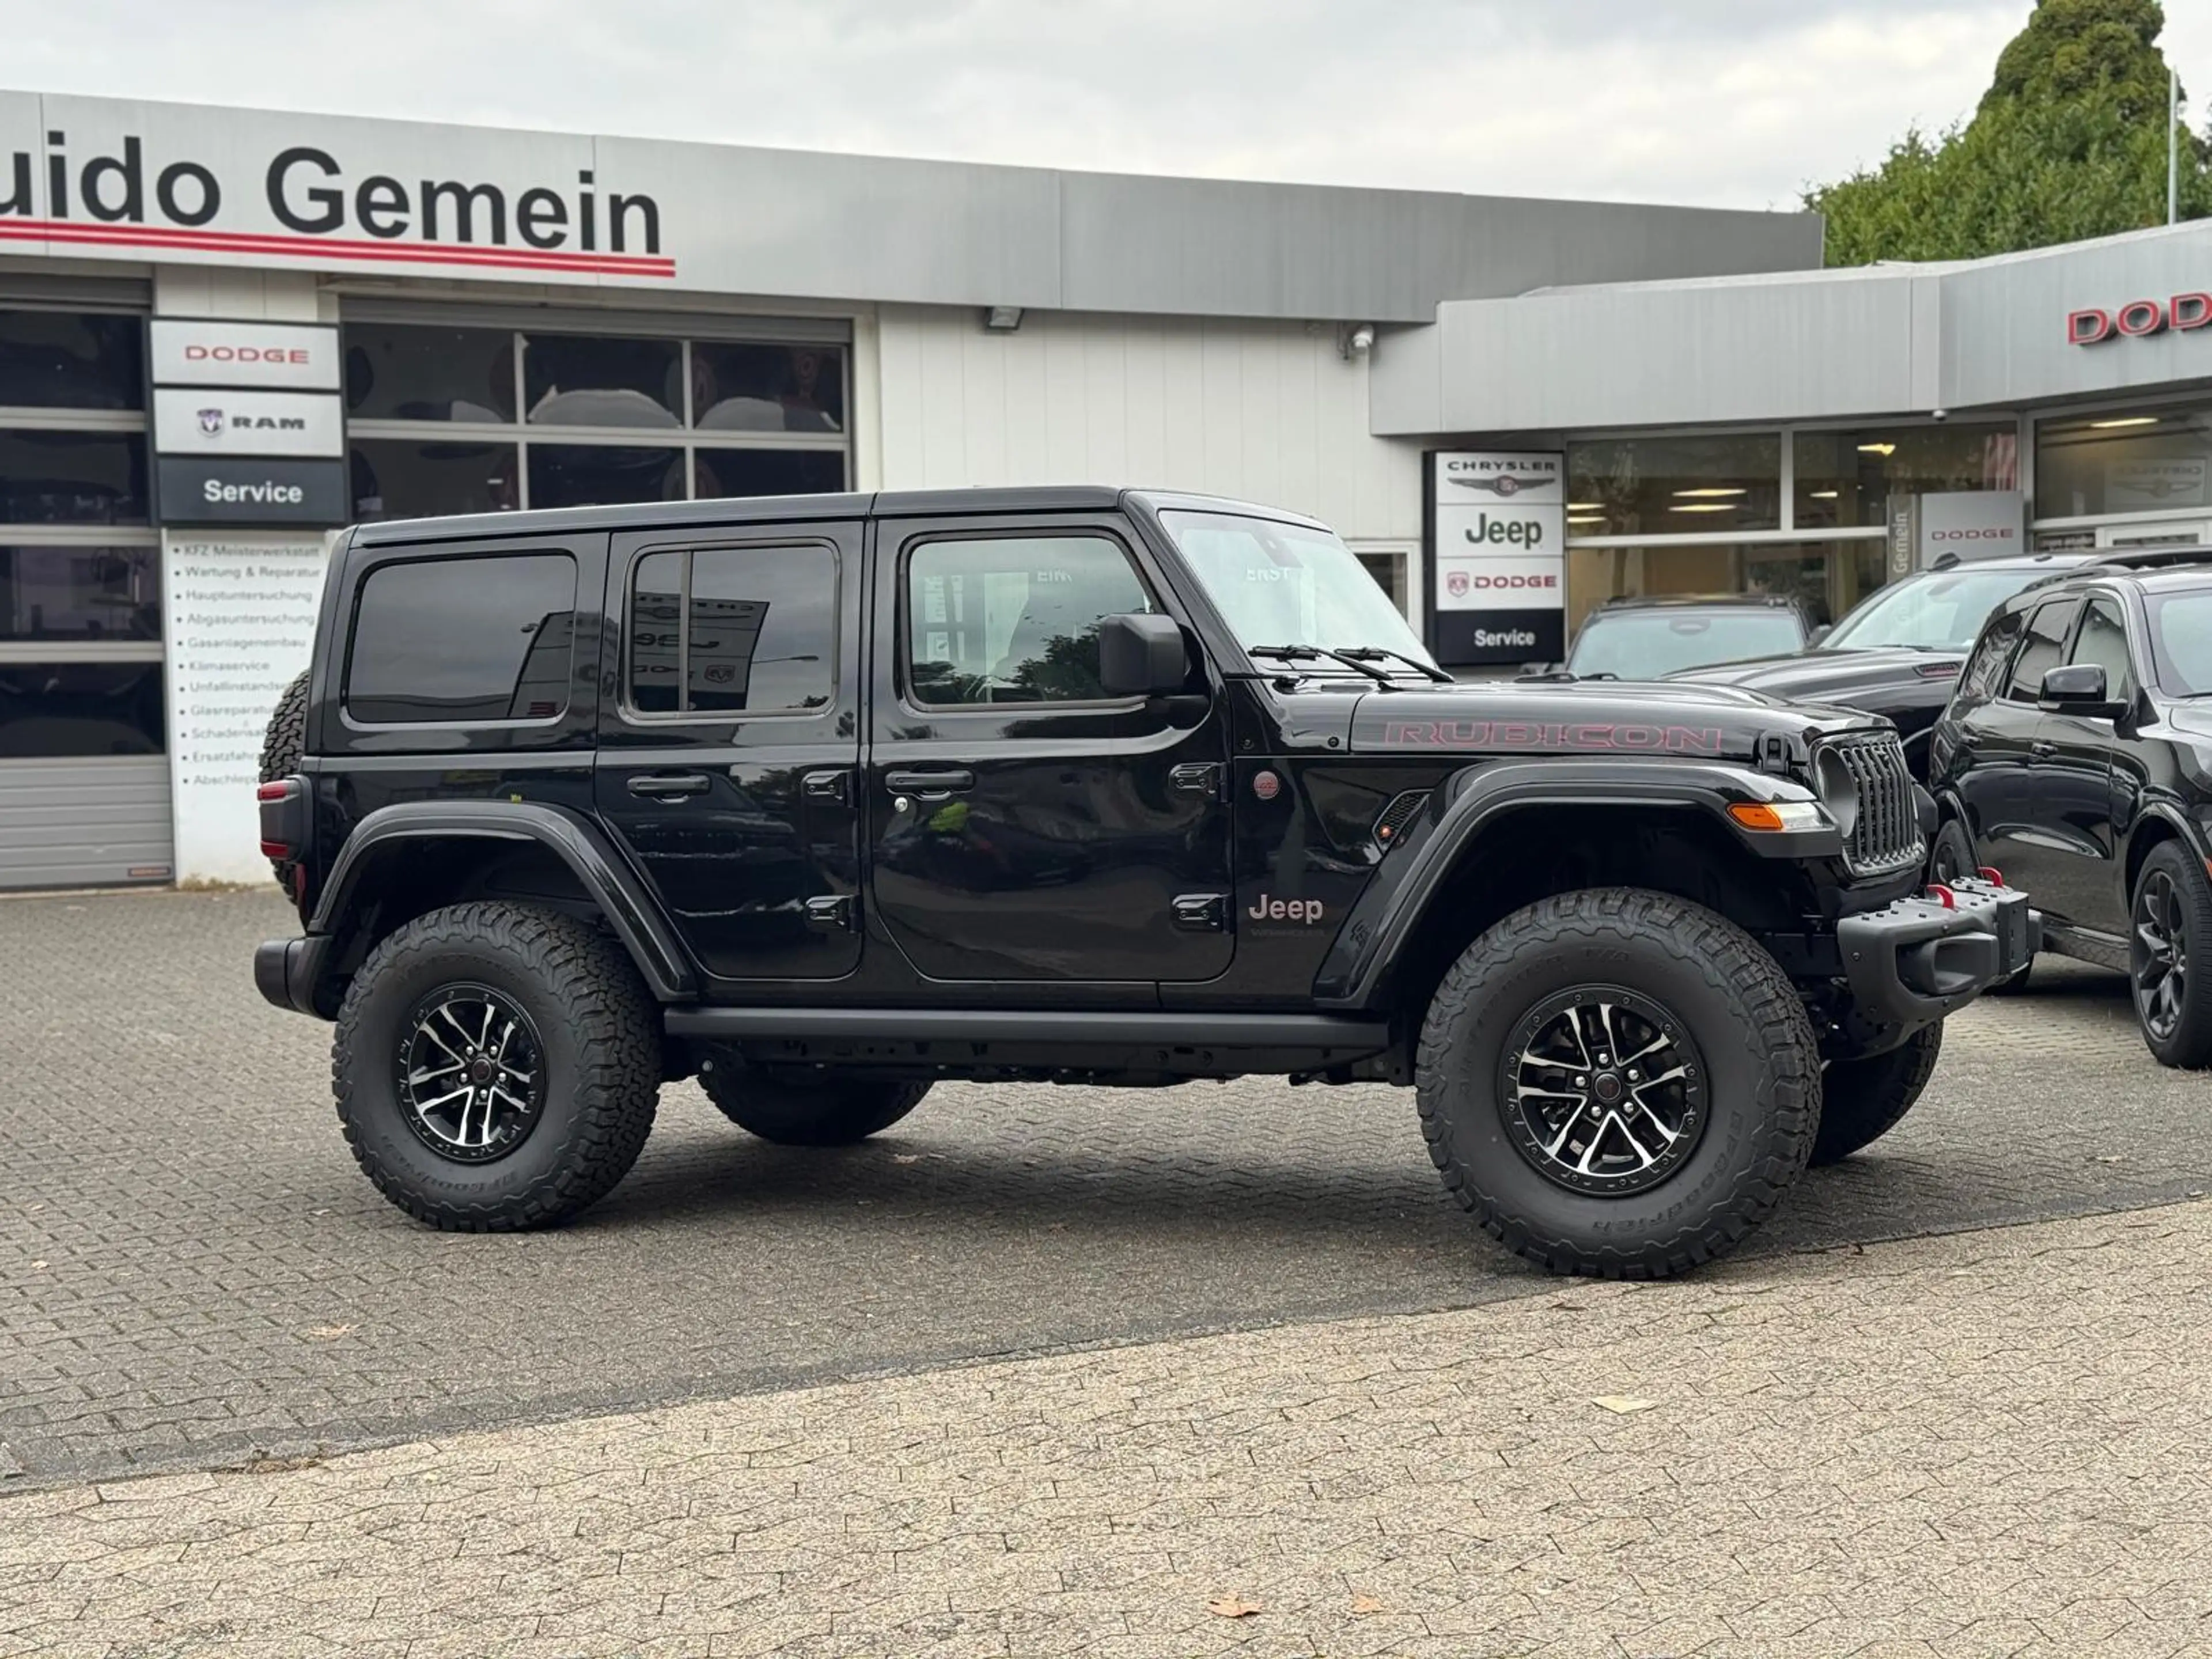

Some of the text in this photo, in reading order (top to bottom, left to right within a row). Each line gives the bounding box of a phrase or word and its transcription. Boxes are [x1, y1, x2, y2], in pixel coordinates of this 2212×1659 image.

[0, 130, 660, 255] uido Gemein
[2067, 292, 2212, 344] DOD
[185, 346, 309, 364] DODGE
[232, 416, 306, 430] RAM
[1447, 461, 1555, 471] CHRYSLER
[203, 479, 304, 503] Service
[1465, 513, 1543, 550] Jeep
[1931, 529, 2014, 540] DODGE
[1893, 512, 1908, 573] Gemein
[185, 566, 241, 580] Wartung
[245, 566, 255, 577] &
[1474, 575, 1557, 589] DODGE
[1474, 629, 1536, 647] Service
[1384, 721, 1722, 749] RUBICON
[1249, 894, 1324, 925] Jeep
